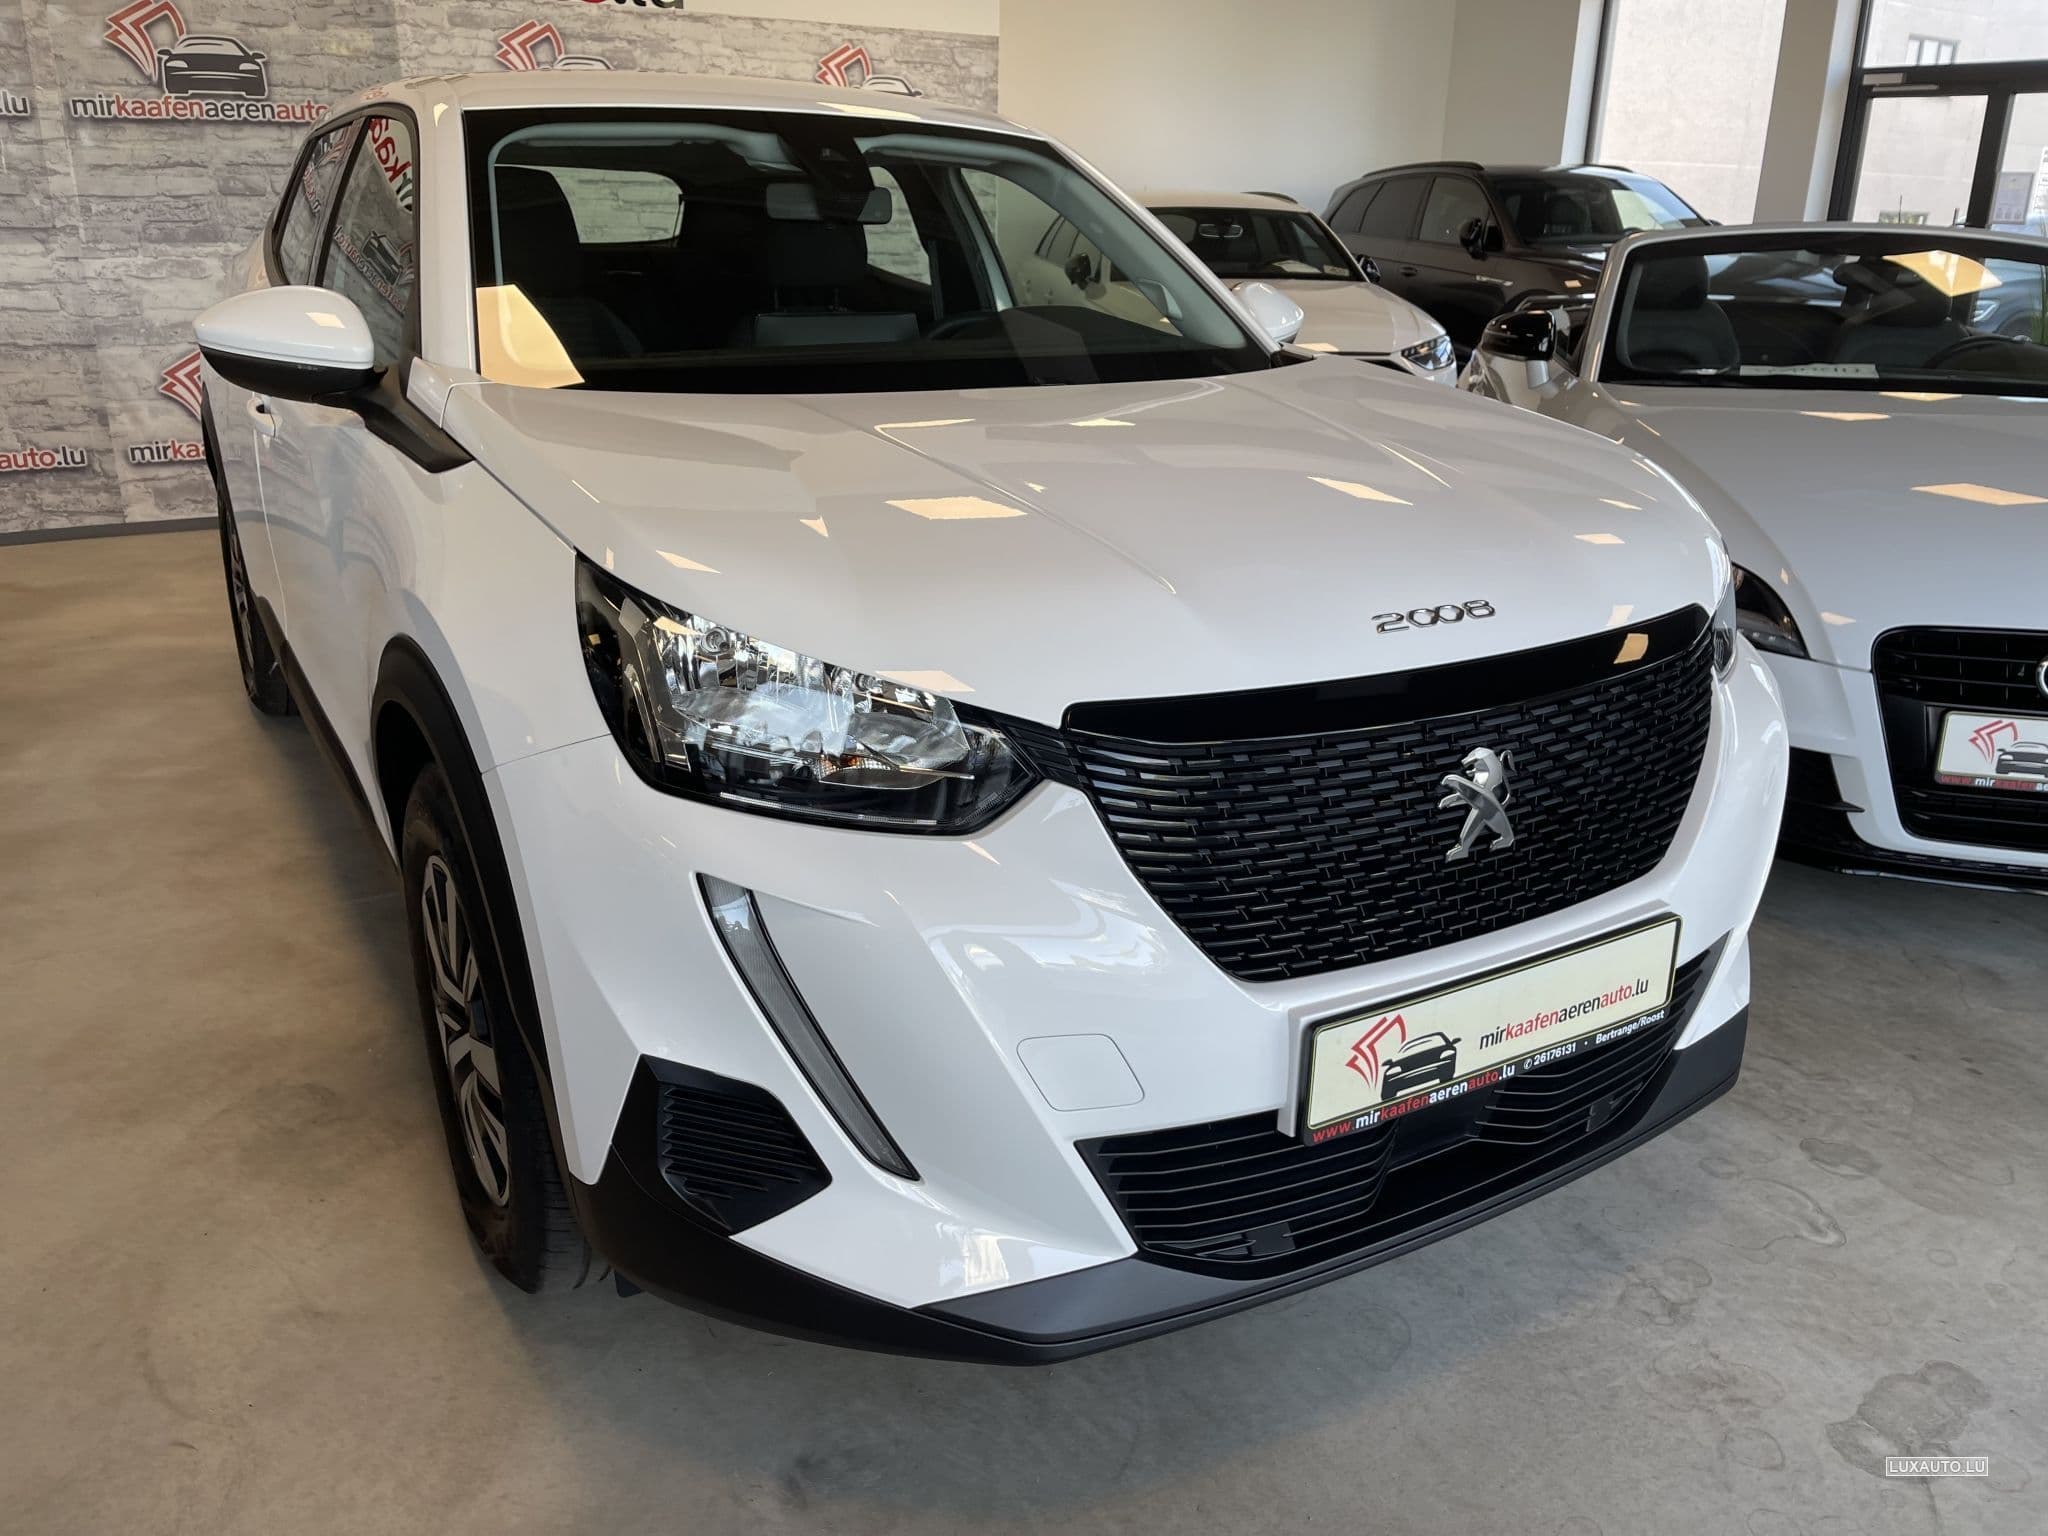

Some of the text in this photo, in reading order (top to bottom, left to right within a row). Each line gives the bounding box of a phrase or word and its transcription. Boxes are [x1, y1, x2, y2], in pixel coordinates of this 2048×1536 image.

[130, 440, 205, 461] mirka
[1371, 600, 1496, 634] 2008
[1479, 978, 1649, 1050] mirkaafenaerenauto.lu
[1595, 1009, 1665, 1044] Bertrange/Roost
